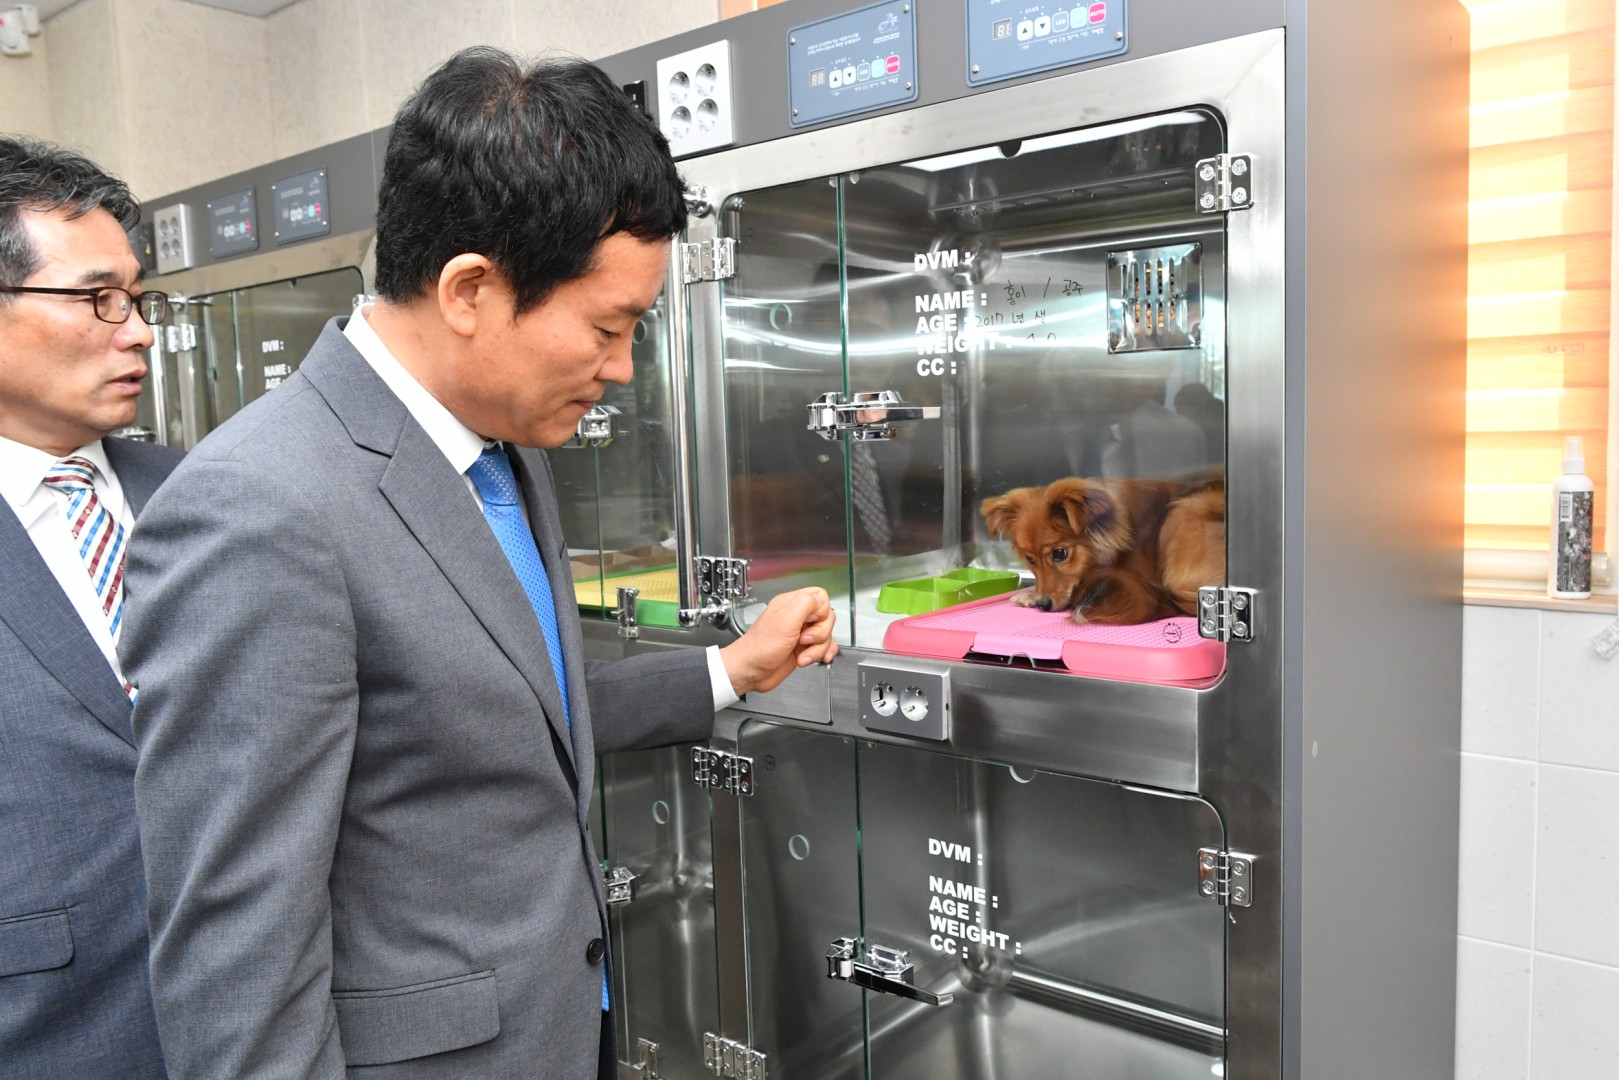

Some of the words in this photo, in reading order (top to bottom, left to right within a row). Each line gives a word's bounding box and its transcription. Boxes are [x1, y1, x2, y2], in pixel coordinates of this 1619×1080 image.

[928, 837, 971, 864] DVM
[929, 875, 987, 906] NAME
[928, 895, 970, 921] AGE
[928, 913, 1010, 951] WEIGHT
[929, 933, 957, 956] CC
